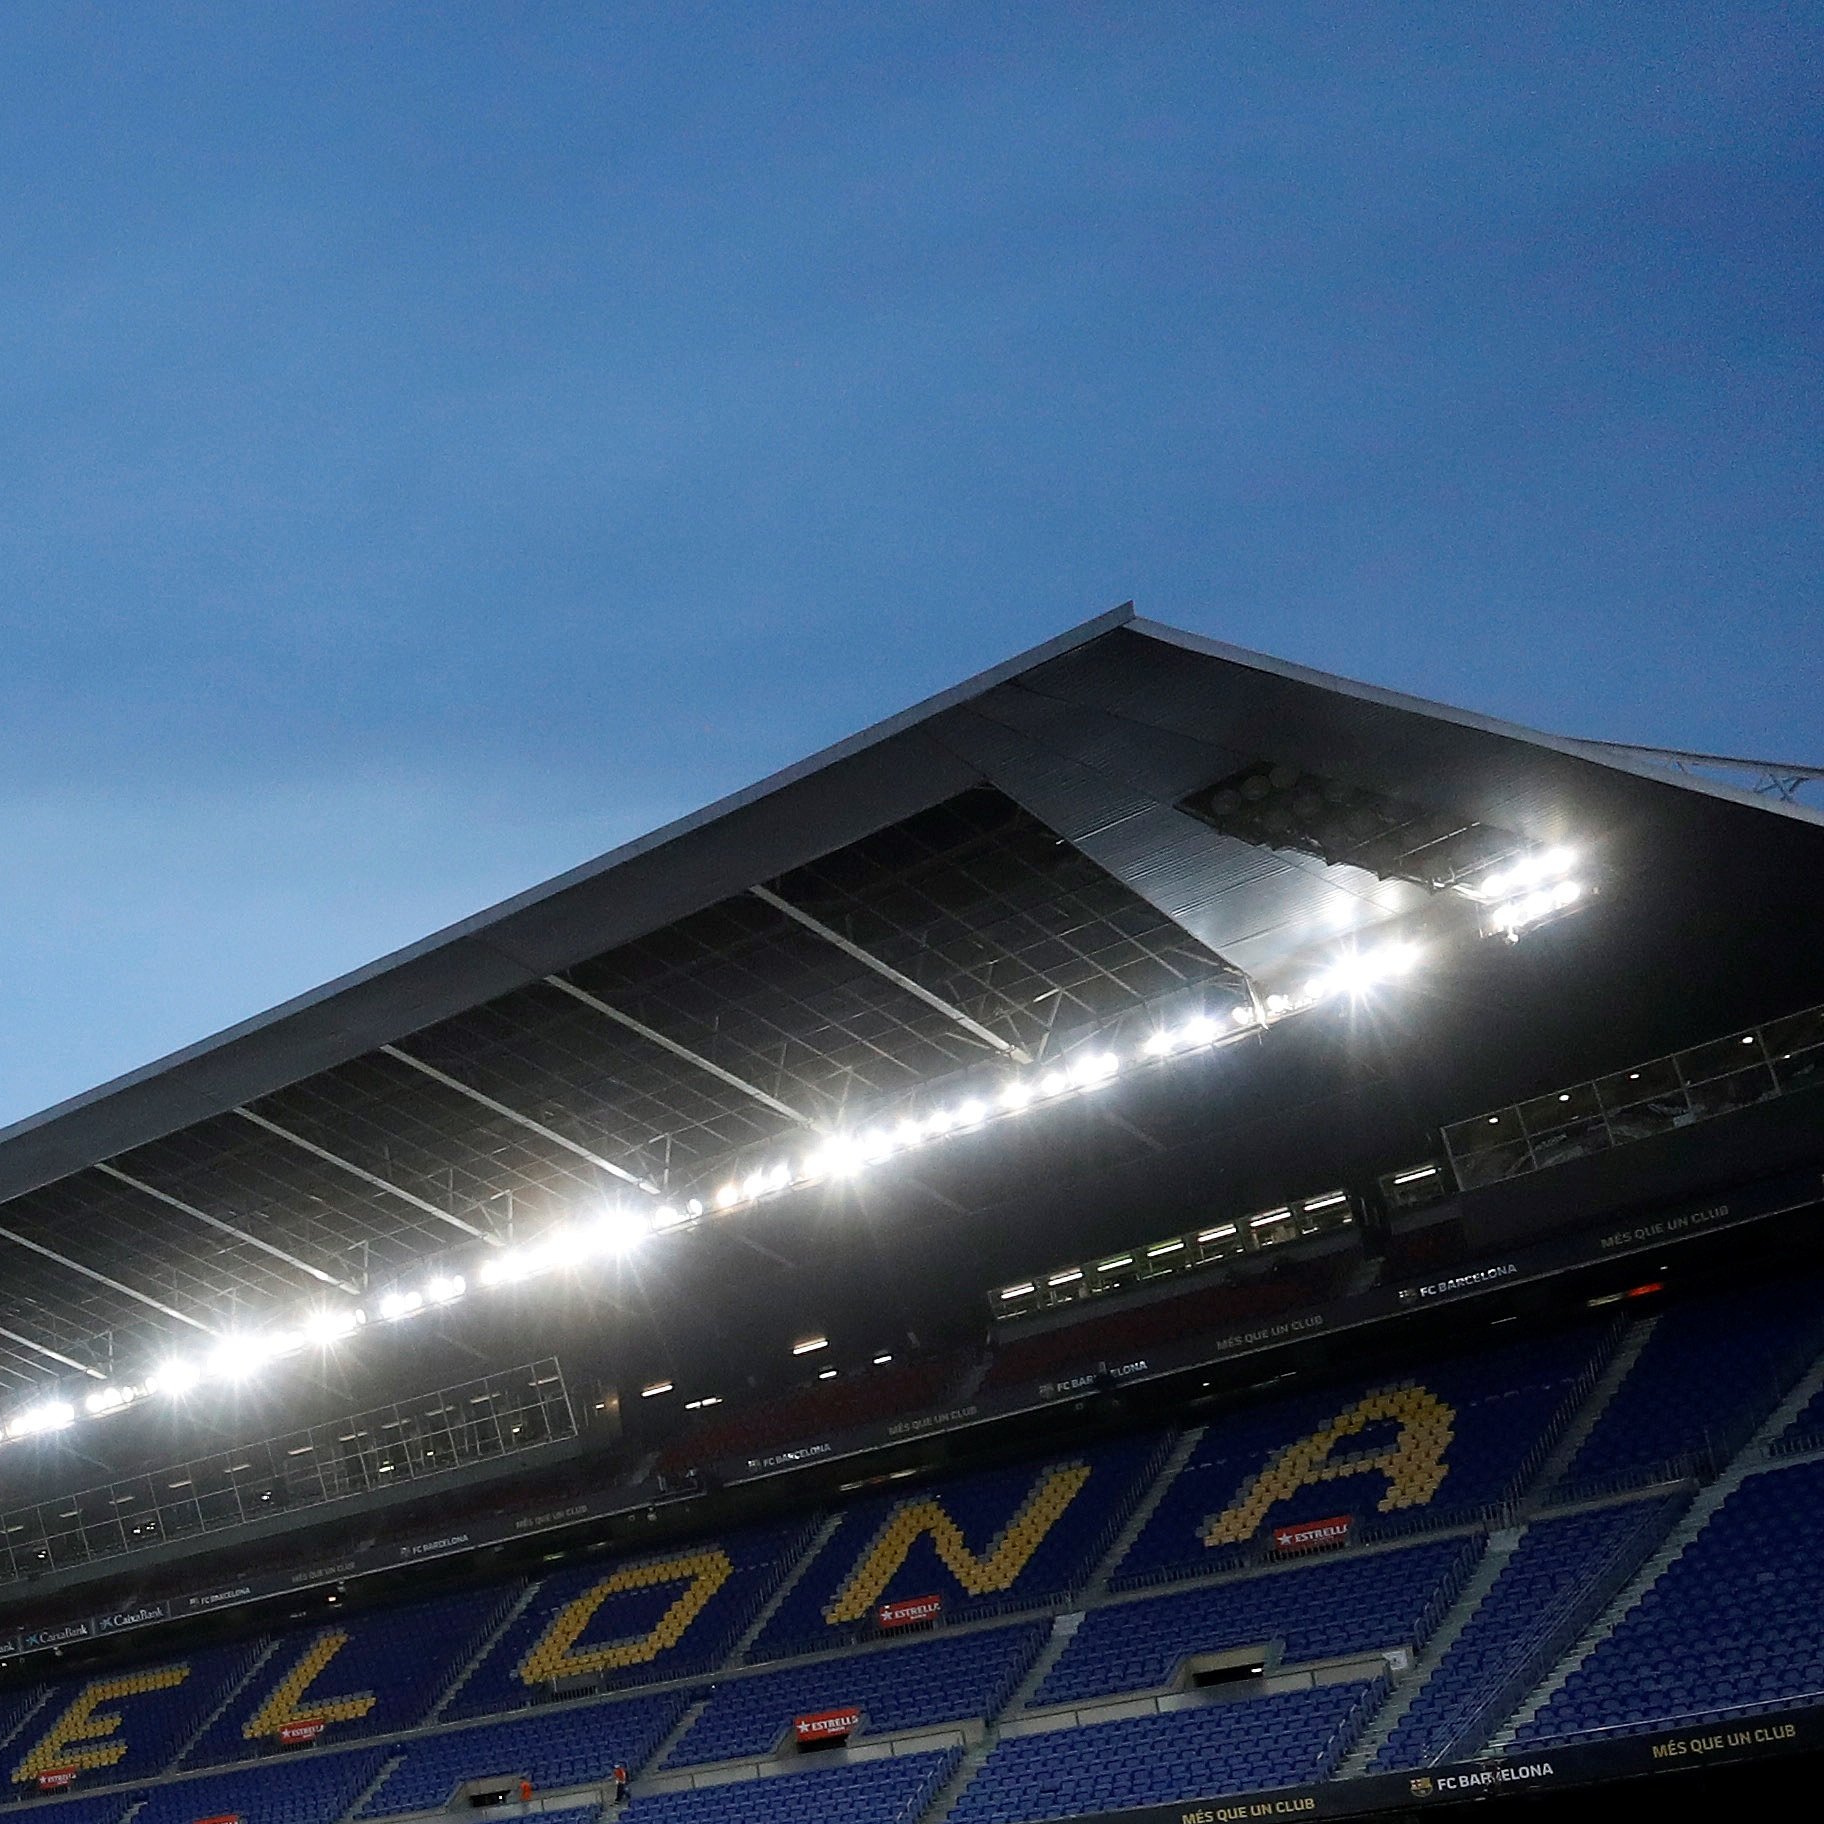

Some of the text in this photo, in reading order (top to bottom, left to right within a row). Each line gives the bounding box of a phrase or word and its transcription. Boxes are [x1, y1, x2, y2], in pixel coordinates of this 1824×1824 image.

[1634, 1224, 1665, 1241] QUE
[1667, 1216, 1688, 1231] UN
[1691, 1205, 1729, 1224] CLUB
[1419, 1263, 1518, 1298] FC BARCELONA
[1291, 1315, 1324, 1332] CLUB
[114, 1607, 164, 1626] CaixaBank
[39, 1624, 88, 1643] CaixaBank
[1652, 1724, 1796, 1759] MÉS QUE UN CLUB
[1437, 1777, 1458, 1791] FC
[1216, 1807, 1248, 1823] QUE
[1249, 1804, 1274, 1817] UN
[1275, 1798, 1316, 1814] CLUB
